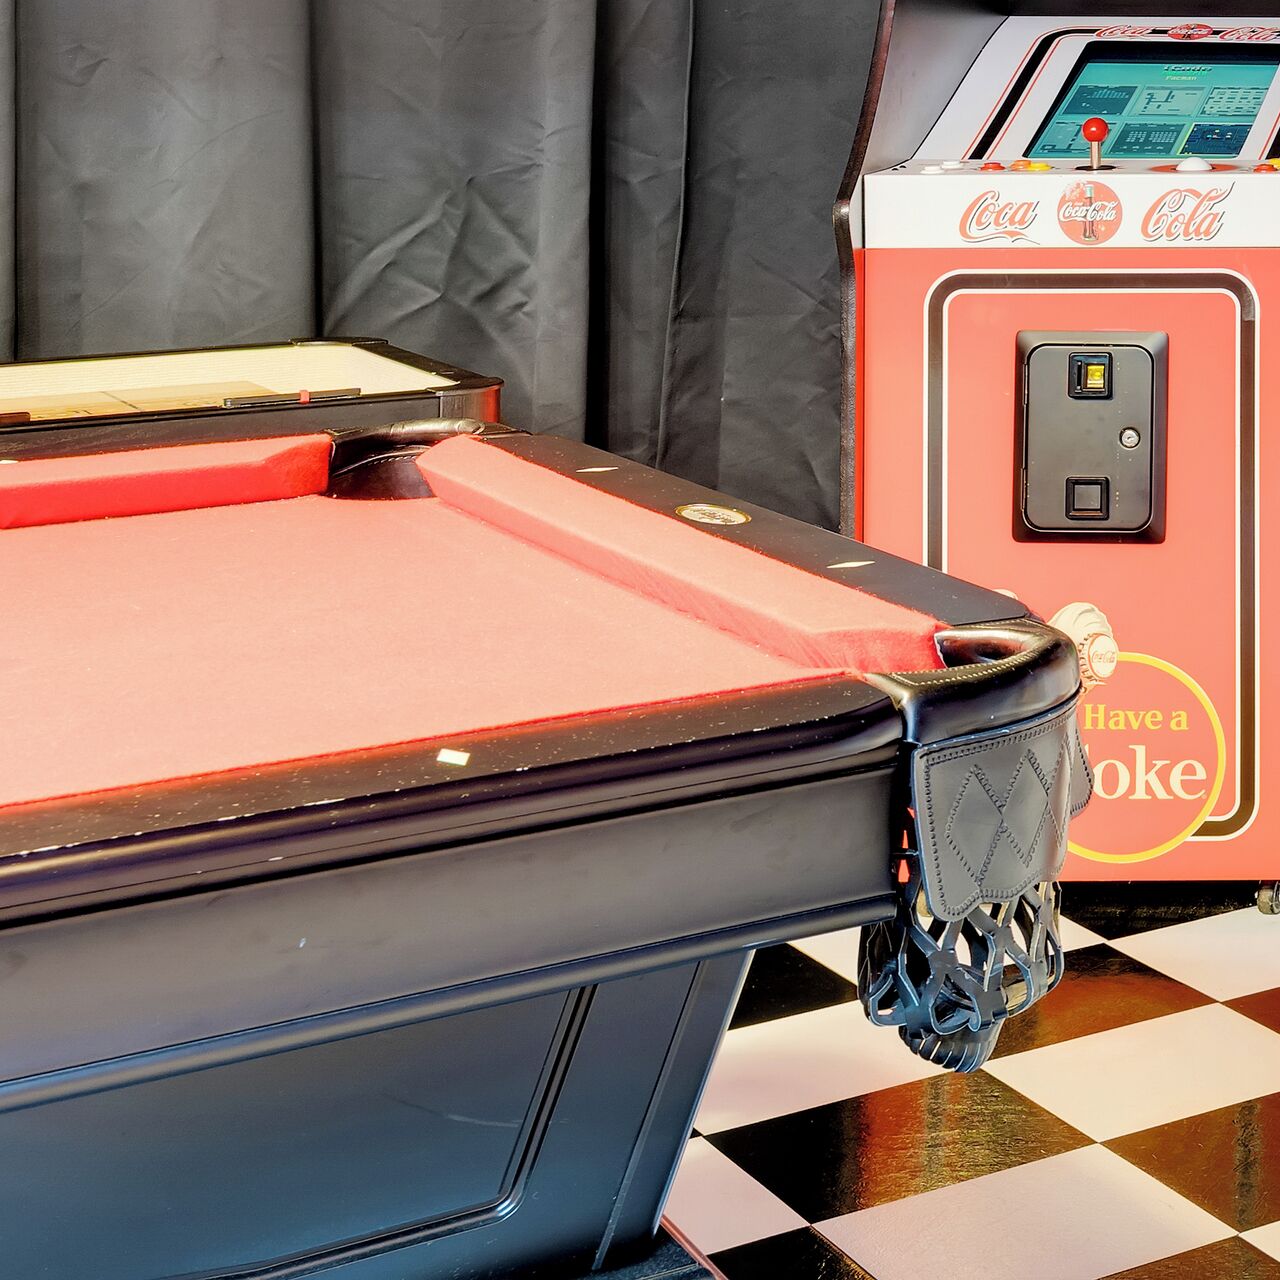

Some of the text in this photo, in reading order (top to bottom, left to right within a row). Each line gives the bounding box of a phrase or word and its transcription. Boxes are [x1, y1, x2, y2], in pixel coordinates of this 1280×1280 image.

[959, 190, 1041, 245] Coca
[1140, 181, 1236, 241] Cola
[1084, 704, 1189, 730] Have a
[1085, 744, 1207, 800] oke
